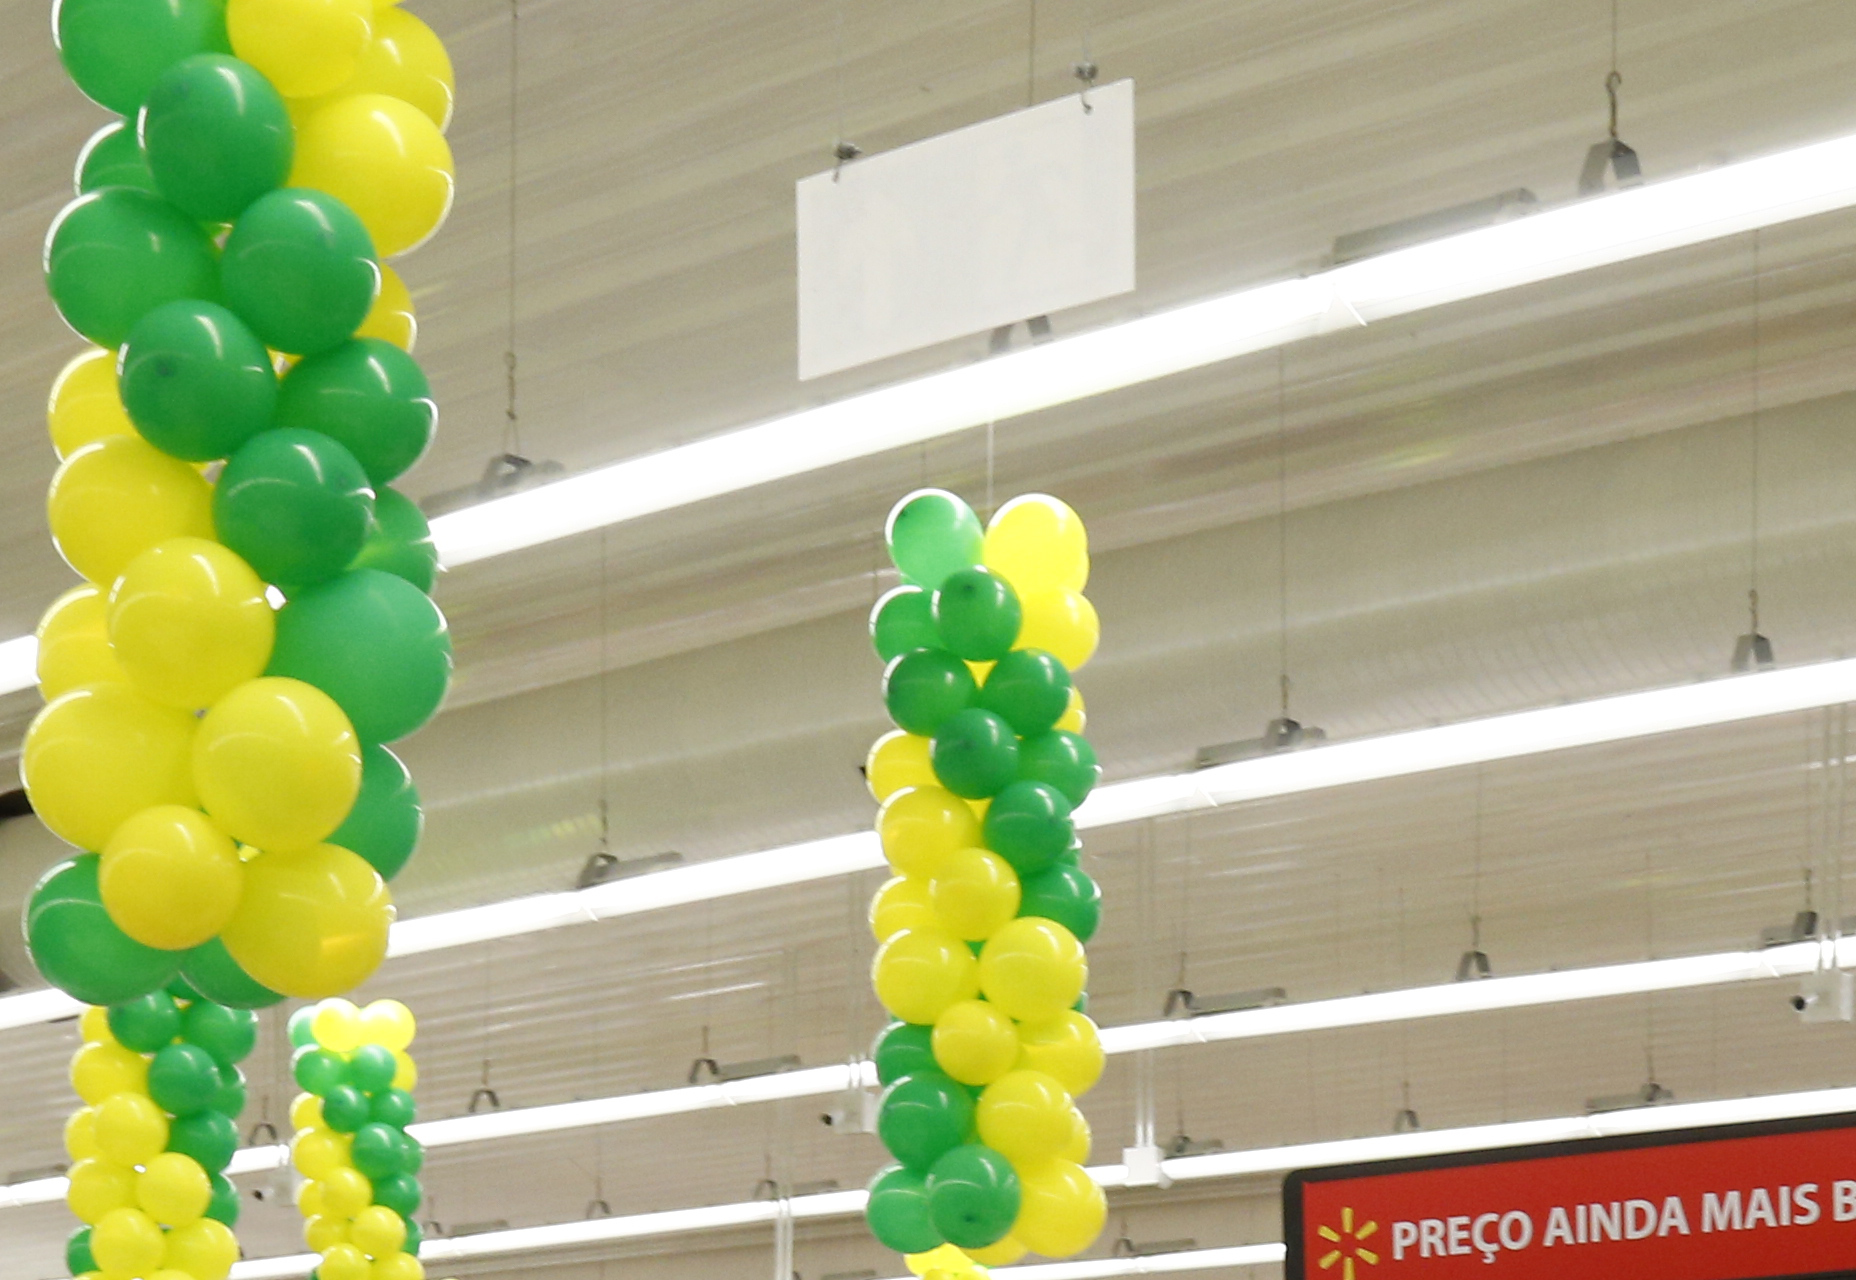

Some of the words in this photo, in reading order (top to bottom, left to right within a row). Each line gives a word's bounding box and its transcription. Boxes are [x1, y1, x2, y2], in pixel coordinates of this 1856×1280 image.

[1392, 1210, 1534, 1263] PREÇO
[1543, 1196, 1687, 1247] AINDA
[1701, 1183, 1820, 1234] MAIS
